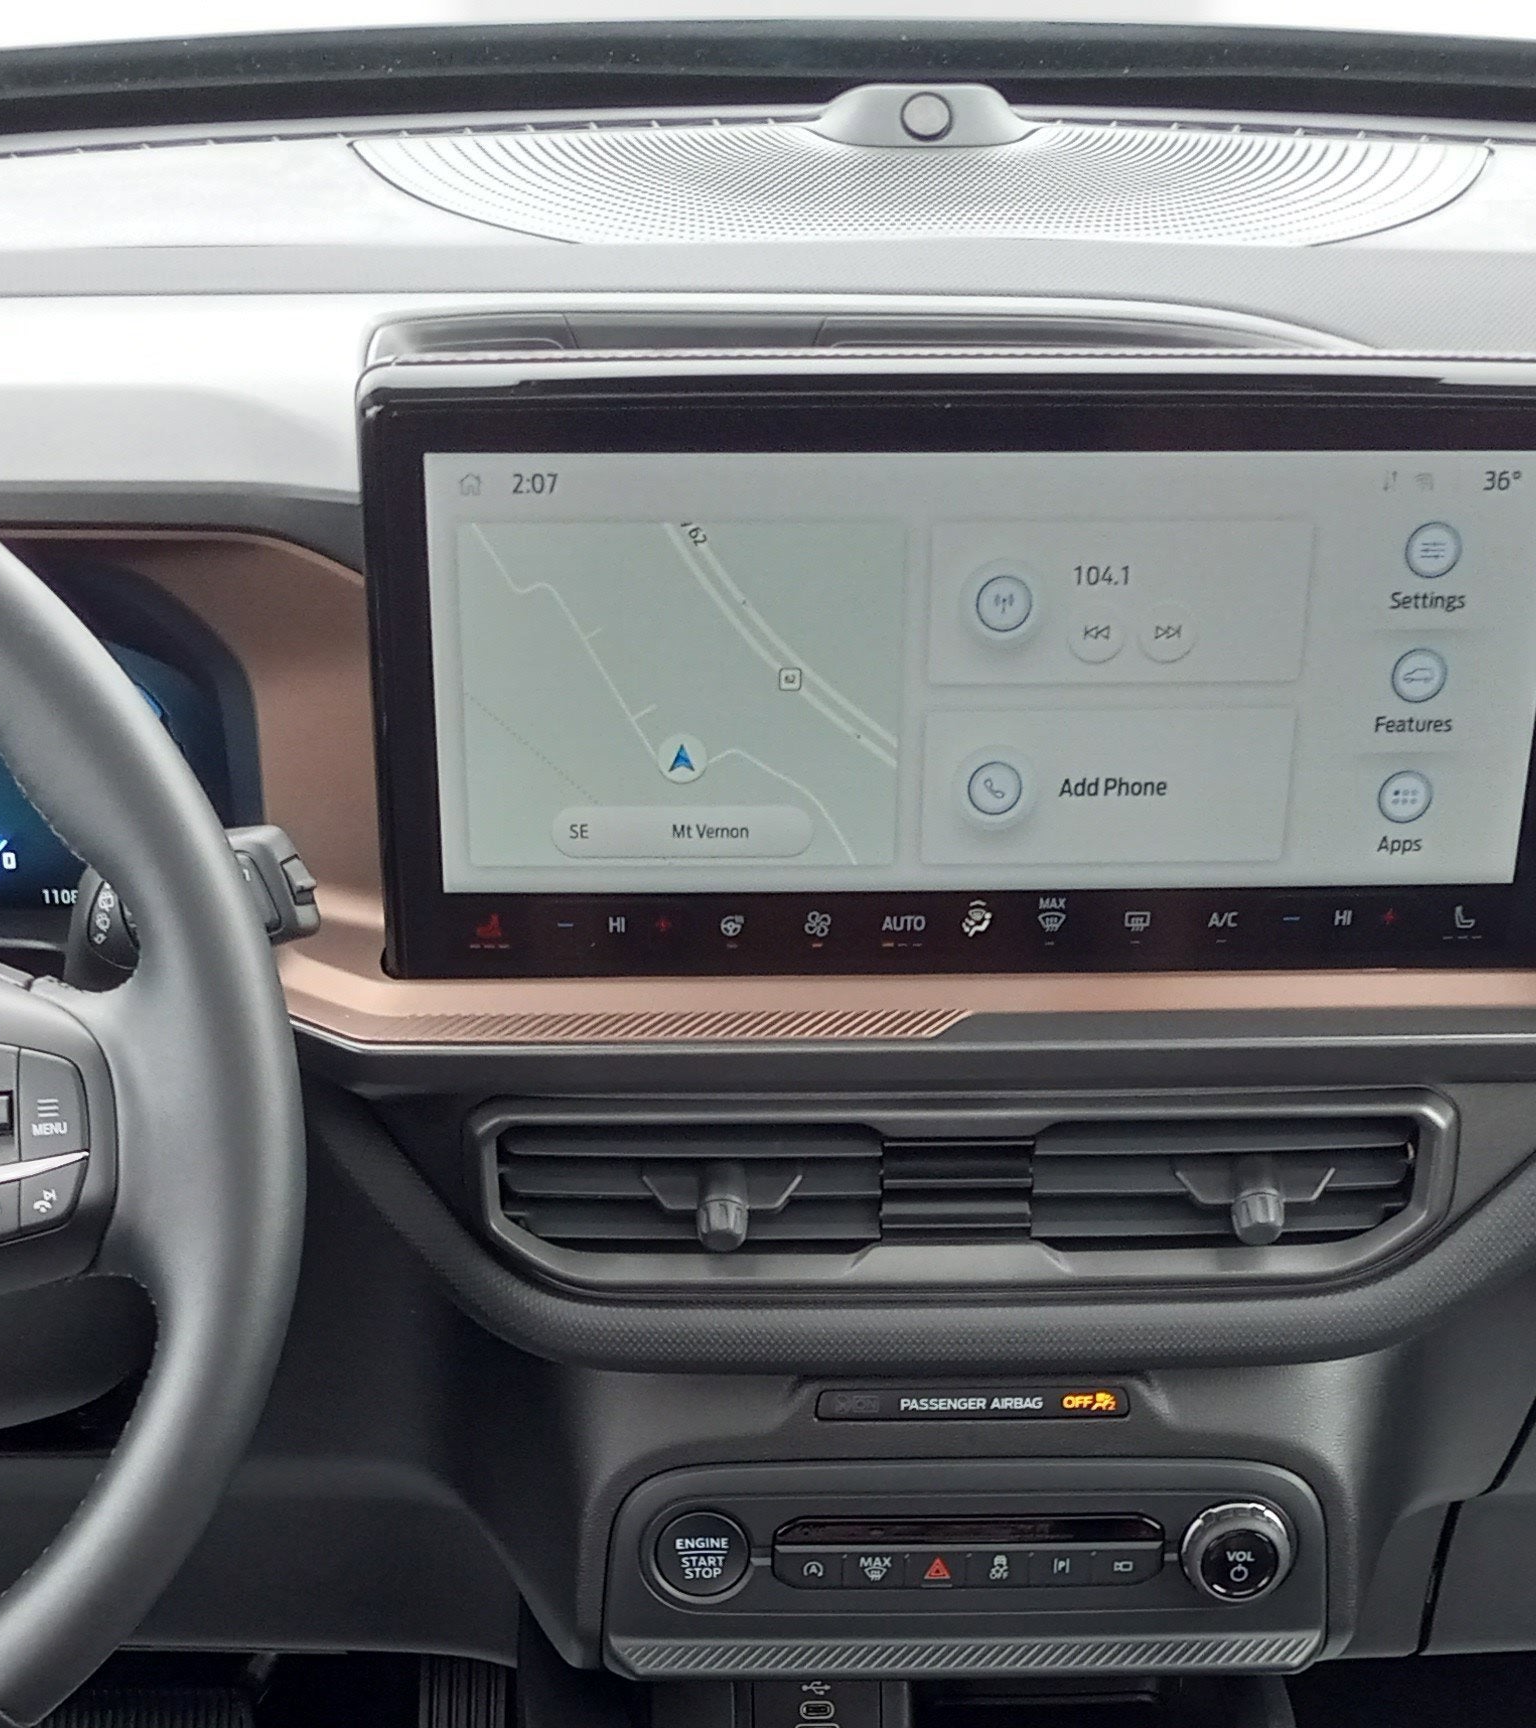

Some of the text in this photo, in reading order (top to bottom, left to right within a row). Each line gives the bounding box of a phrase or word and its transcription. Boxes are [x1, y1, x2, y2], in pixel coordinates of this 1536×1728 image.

[512, 472, 558, 495] 2:07
[1073, 565, 1131, 586] 104.1
[1390, 592, 1466, 612] Settings
[1374, 716, 1453, 733] Features
[1059, 778, 1168, 797] Add Phone
[569, 824, 590, 840] SE
[671, 824, 750, 840] Mt Vernon
[1377, 836, 1422, 854] Apps
[2, 852, 17, 869] 0
[1038, 898, 1065, 909] MAX
[608, 916, 625, 933] HI
[882, 915, 925, 932] AUTO
[1207, 912, 1238, 927] A/C
[1334, 910, 1351, 926] HI
[32, 1121, 68, 1137] MENU
[900, 1395, 1094, 1411] PASSENGER AIRBAG OFF
[675, 1538, 729, 1551] ENGINE
[681, 1555, 725, 1569] START
[860, 1556, 891, 1568] MAX
[1225, 1551, 1255, 1564] VOL
[684, 1565, 722, 1580] STOP
